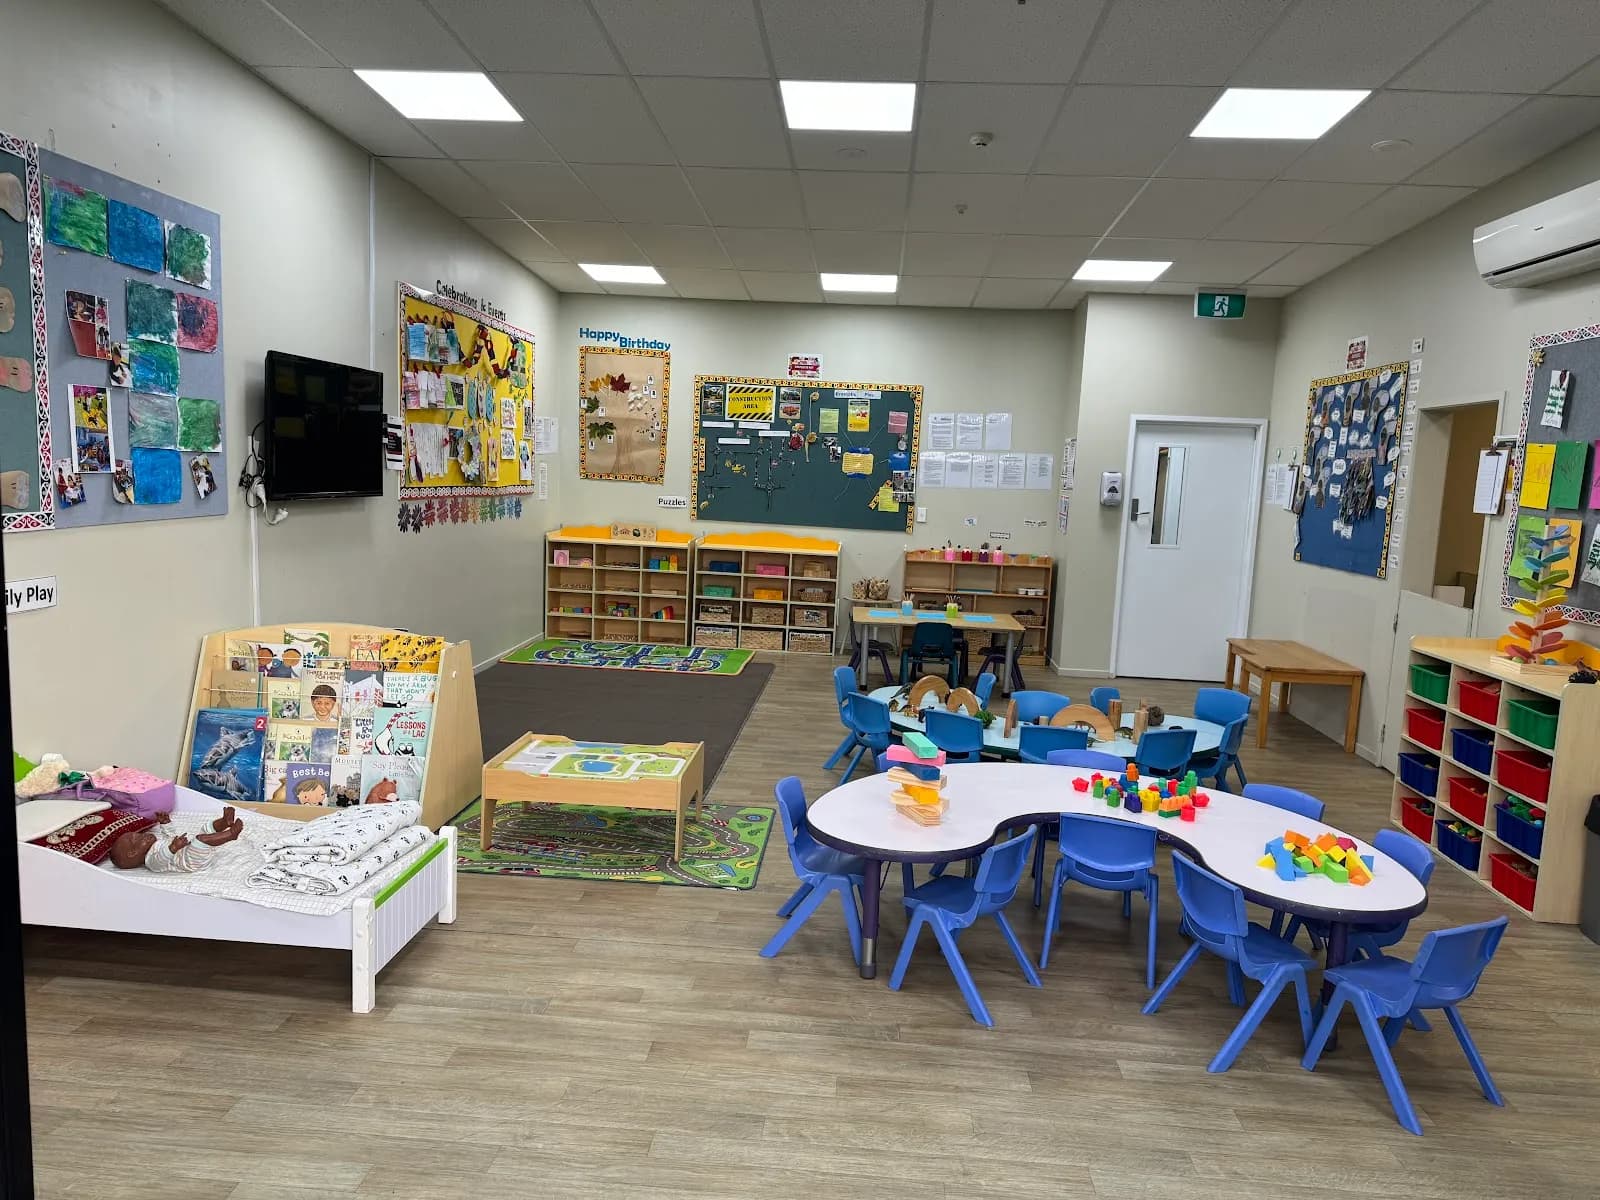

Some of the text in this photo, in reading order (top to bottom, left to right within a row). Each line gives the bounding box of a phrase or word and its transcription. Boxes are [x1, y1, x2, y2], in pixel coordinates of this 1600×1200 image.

[436, 279, 478, 309] Celebrations
[487, 302, 507, 322] Events
[579, 327, 671, 351] Happy Birthday
[658, 498, 686, 506] Puzzles
[27, 585, 53, 603] Play
[256, 719, 264, 729] 2
[396, 721, 426, 730] LESSONS
[412, 730, 425, 738] LAC
